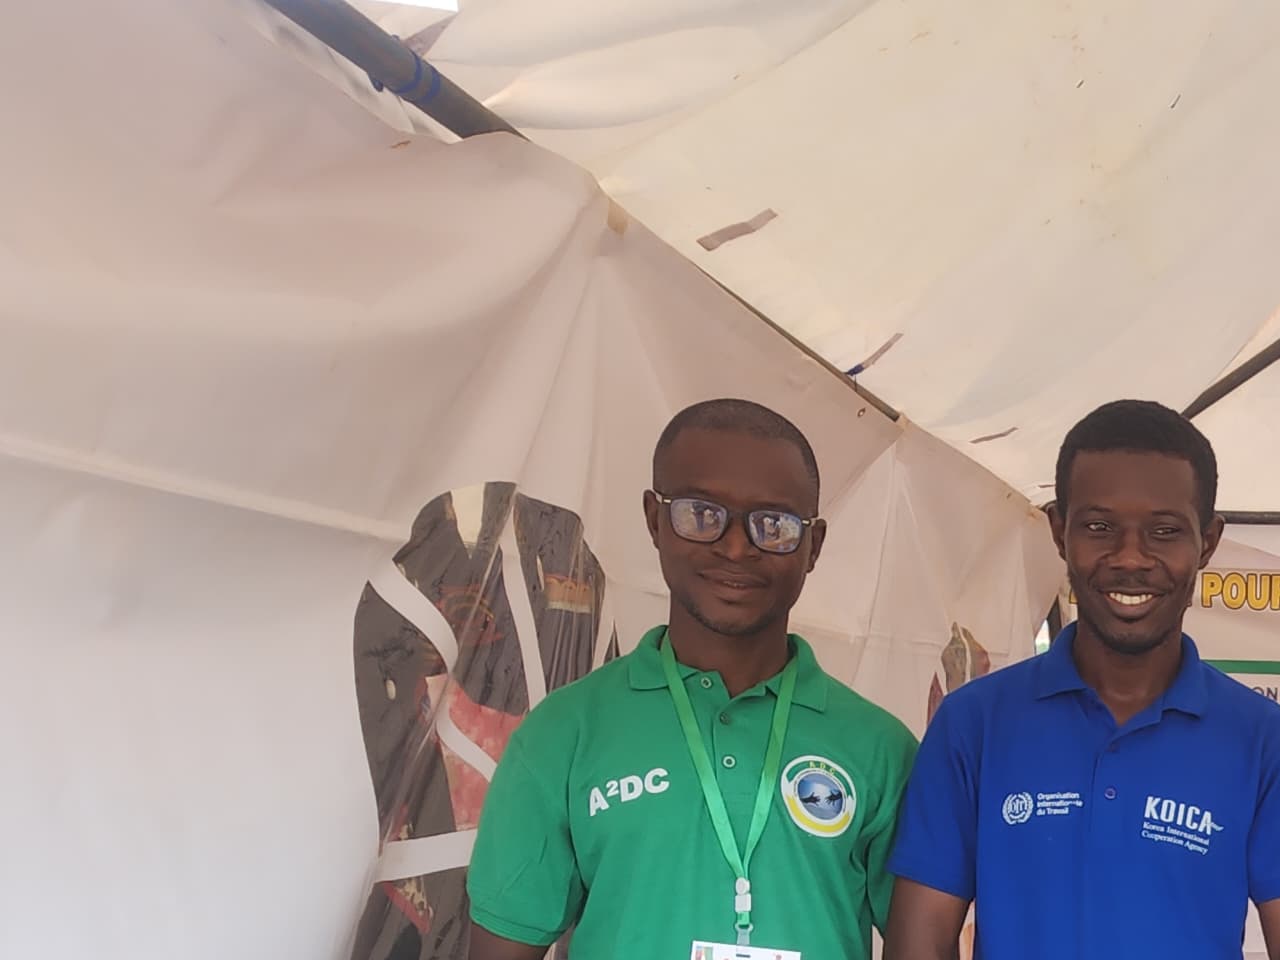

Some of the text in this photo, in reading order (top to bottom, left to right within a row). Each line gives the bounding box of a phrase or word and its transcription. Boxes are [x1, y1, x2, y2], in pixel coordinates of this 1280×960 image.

[1144, 796, 1219, 836] KOICA
[1141, 829, 1209, 856] Cooperation Agency
[1143, 821, 1210, 846] Korea International
